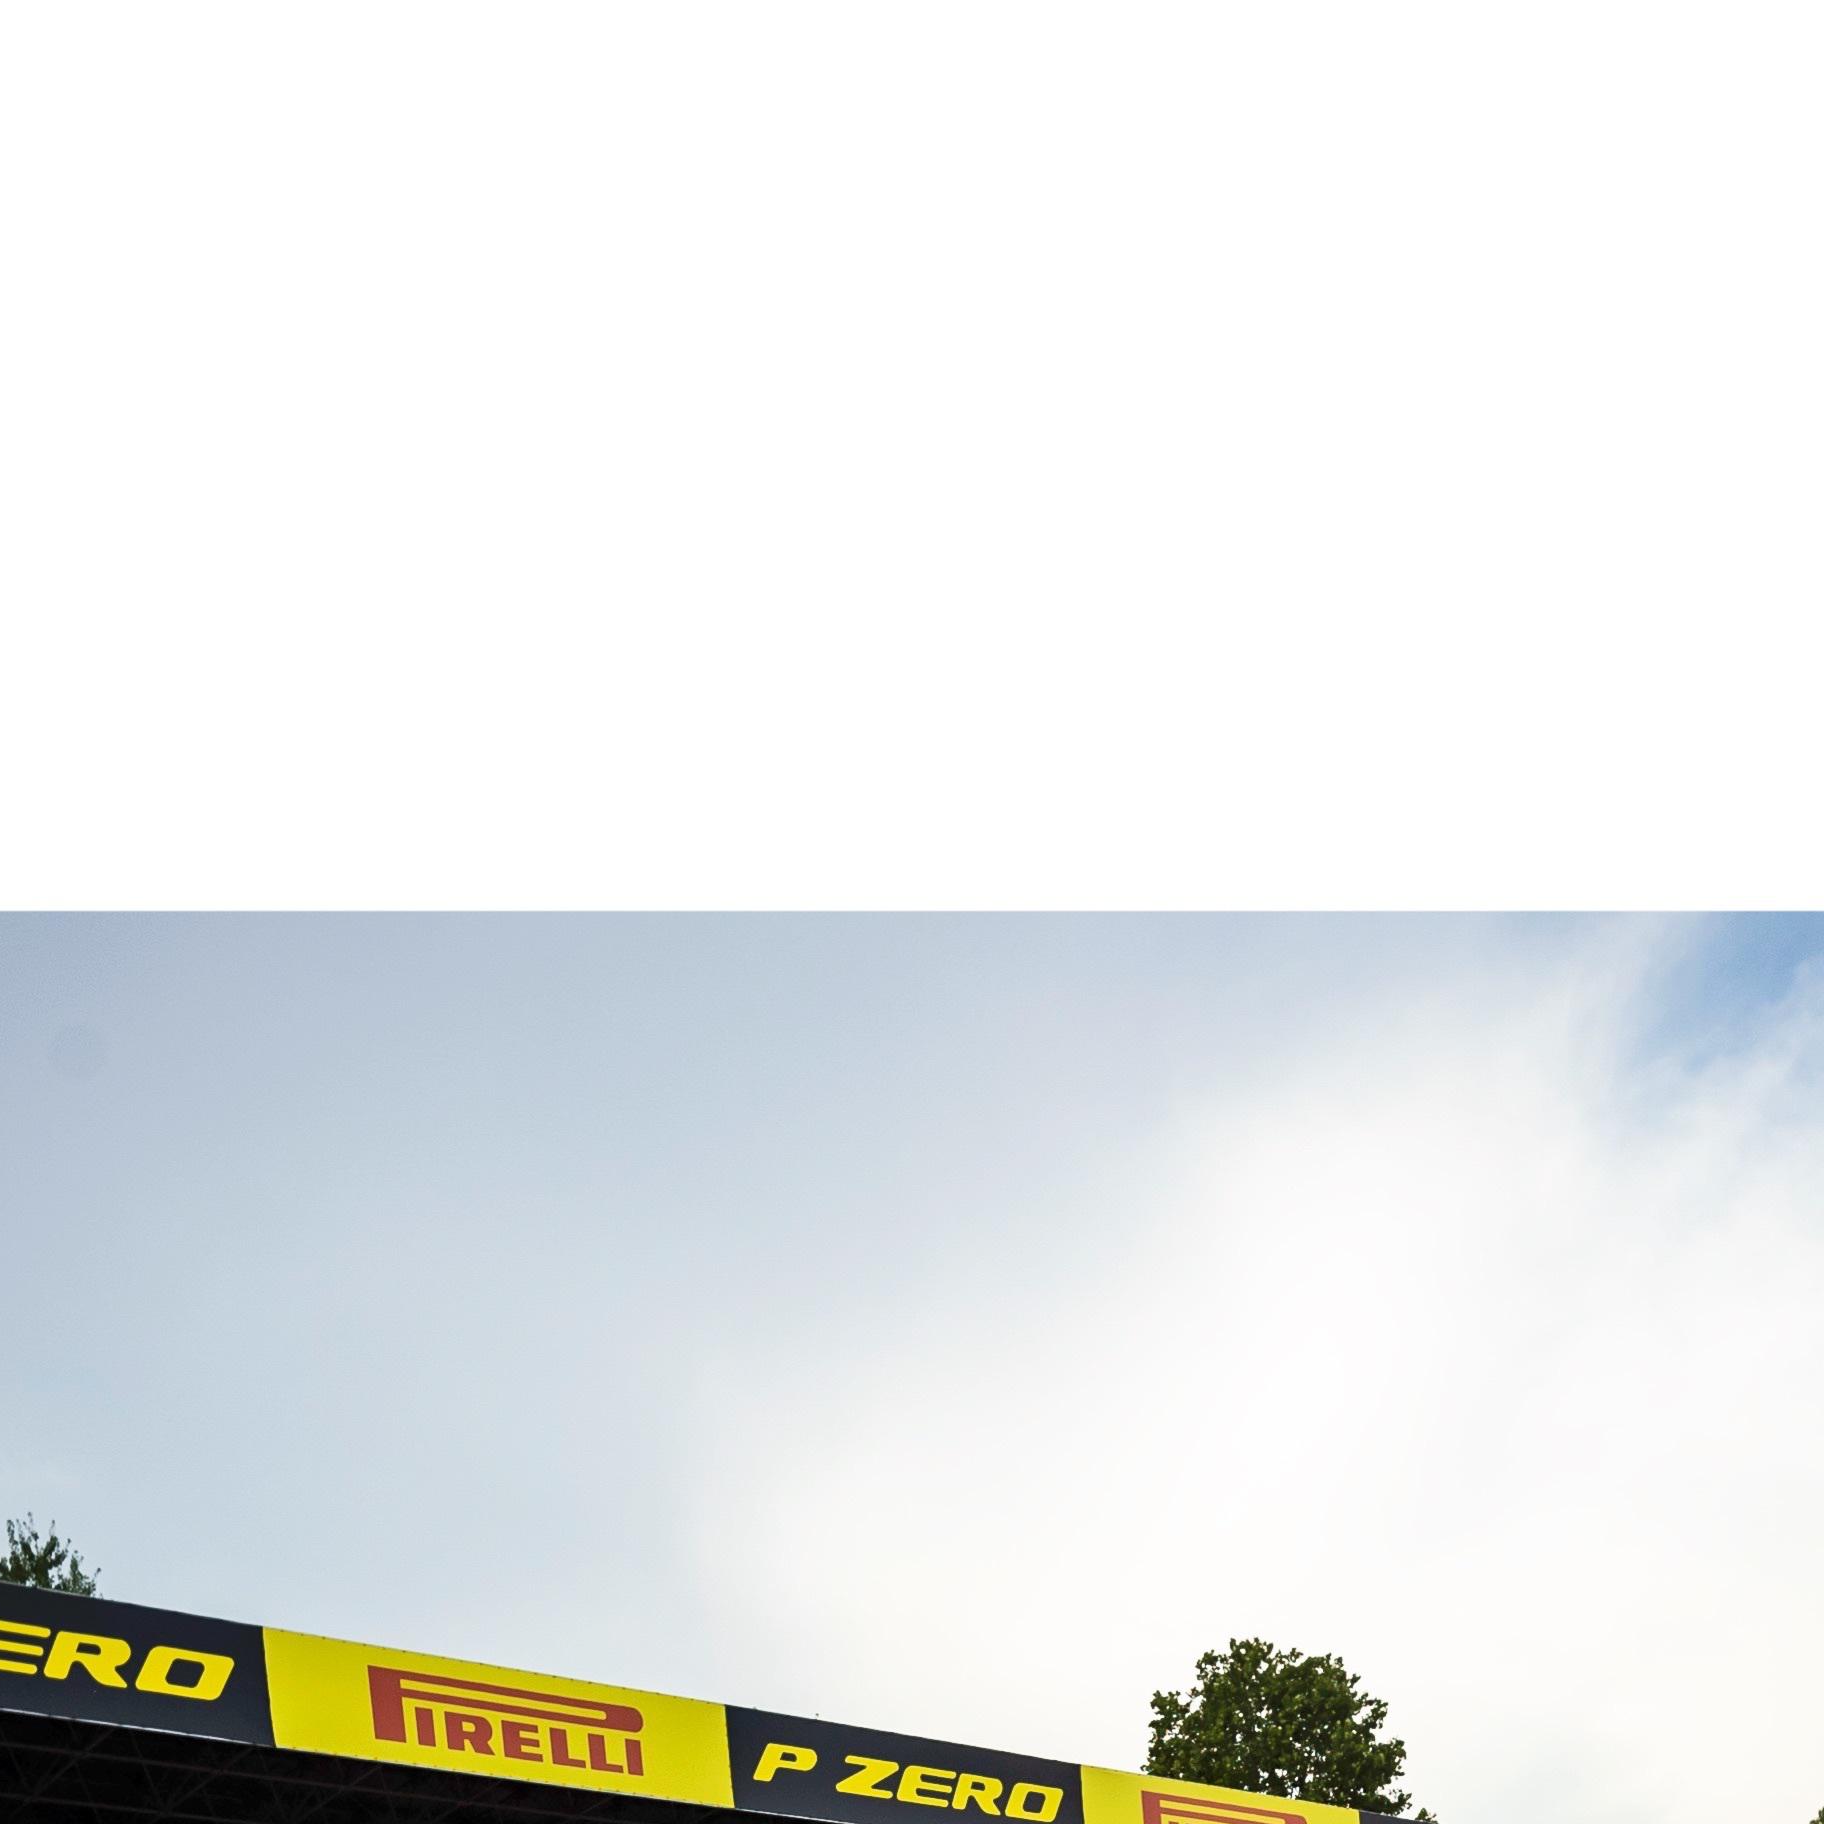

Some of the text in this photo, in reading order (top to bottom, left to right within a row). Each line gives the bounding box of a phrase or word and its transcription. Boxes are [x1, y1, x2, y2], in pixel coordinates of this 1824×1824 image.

[367, 1665, 644, 1776] PIRELLI
[753, 1743, 1064, 1823] P ZERO
